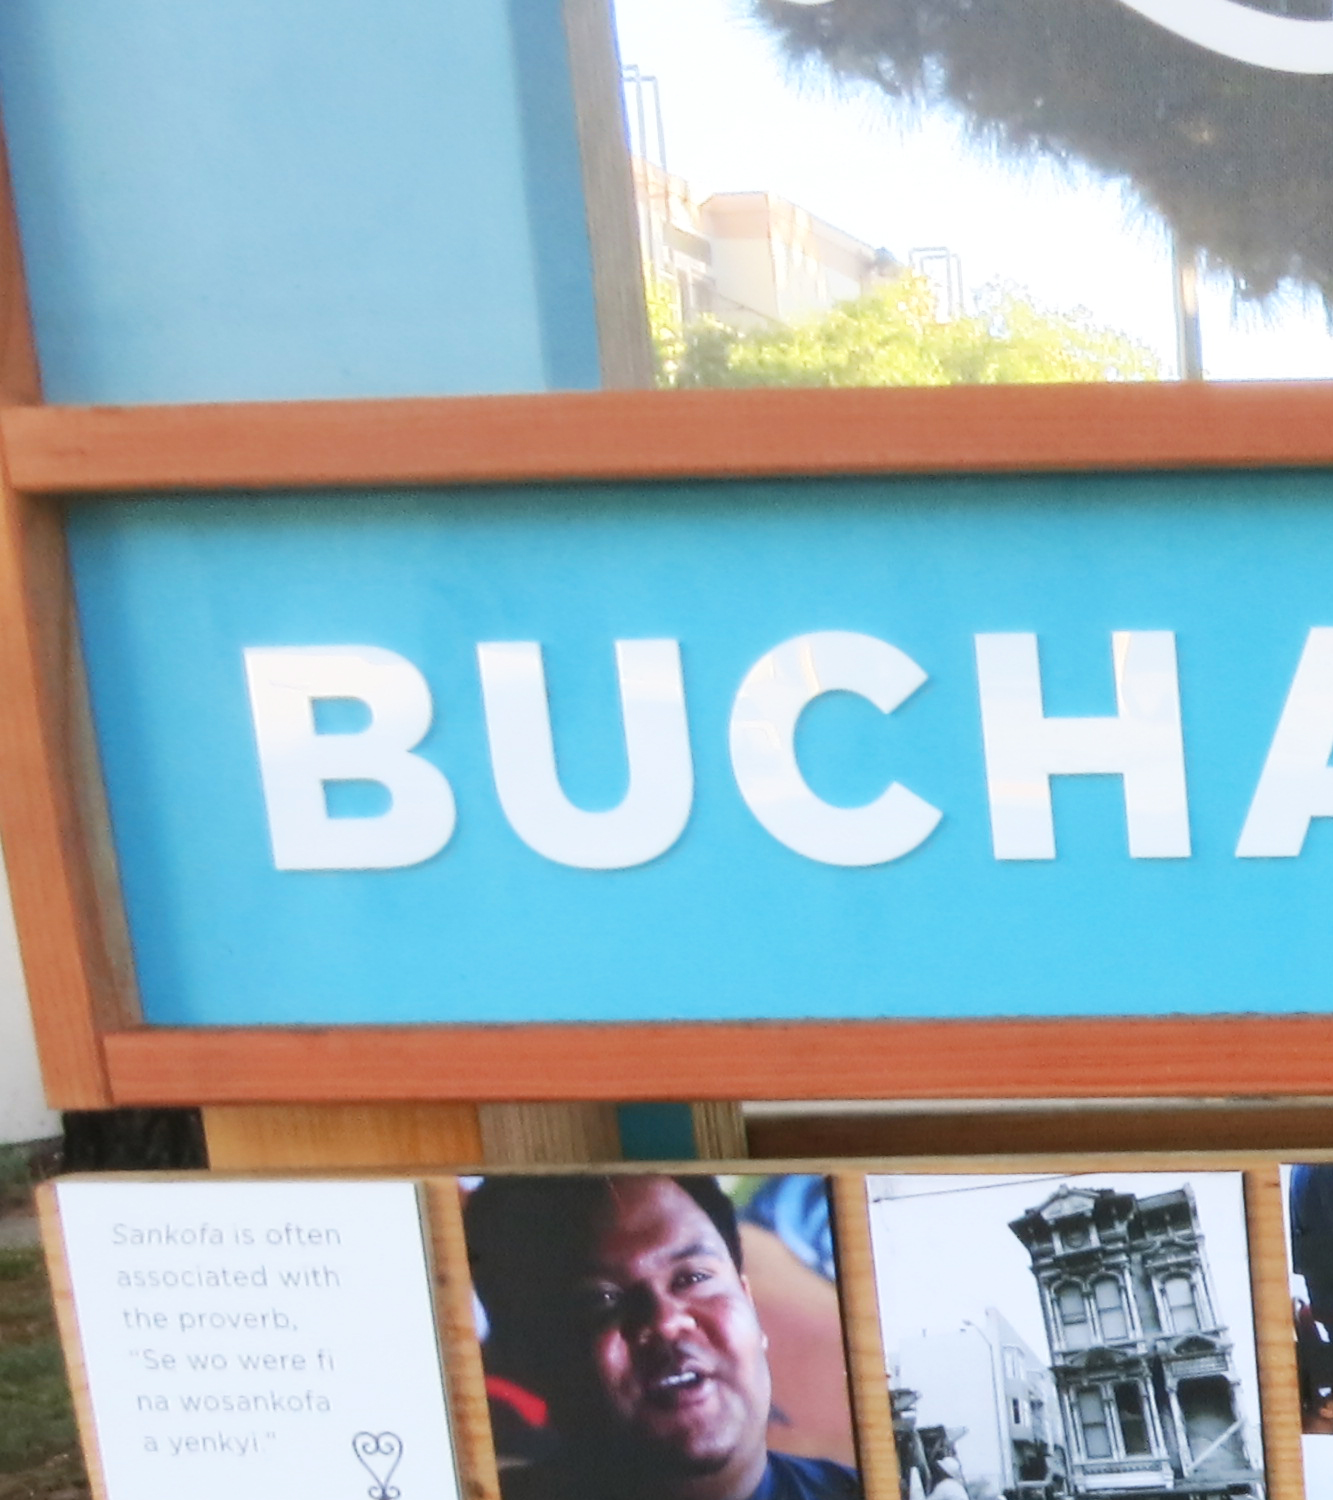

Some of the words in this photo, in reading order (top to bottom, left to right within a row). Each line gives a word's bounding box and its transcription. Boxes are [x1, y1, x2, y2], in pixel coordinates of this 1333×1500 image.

[112, 1223, 224, 1245] Sankofa
[234, 1227, 255, 1245] is
[266, 1222, 342, 1245] often
[117, 1265, 268, 1287] associated
[279, 1265, 341, 1287] with
[123, 1308, 167, 1328] the
[179, 1308, 298, 1332] proverb,
[187, 1354, 228, 1370] wo
[239, 1354, 306, 1370] were
[137, 1395, 169, 1412] na
[181, 1390, 331, 1412] wosankofa
[144, 1436, 158, 1452] a
